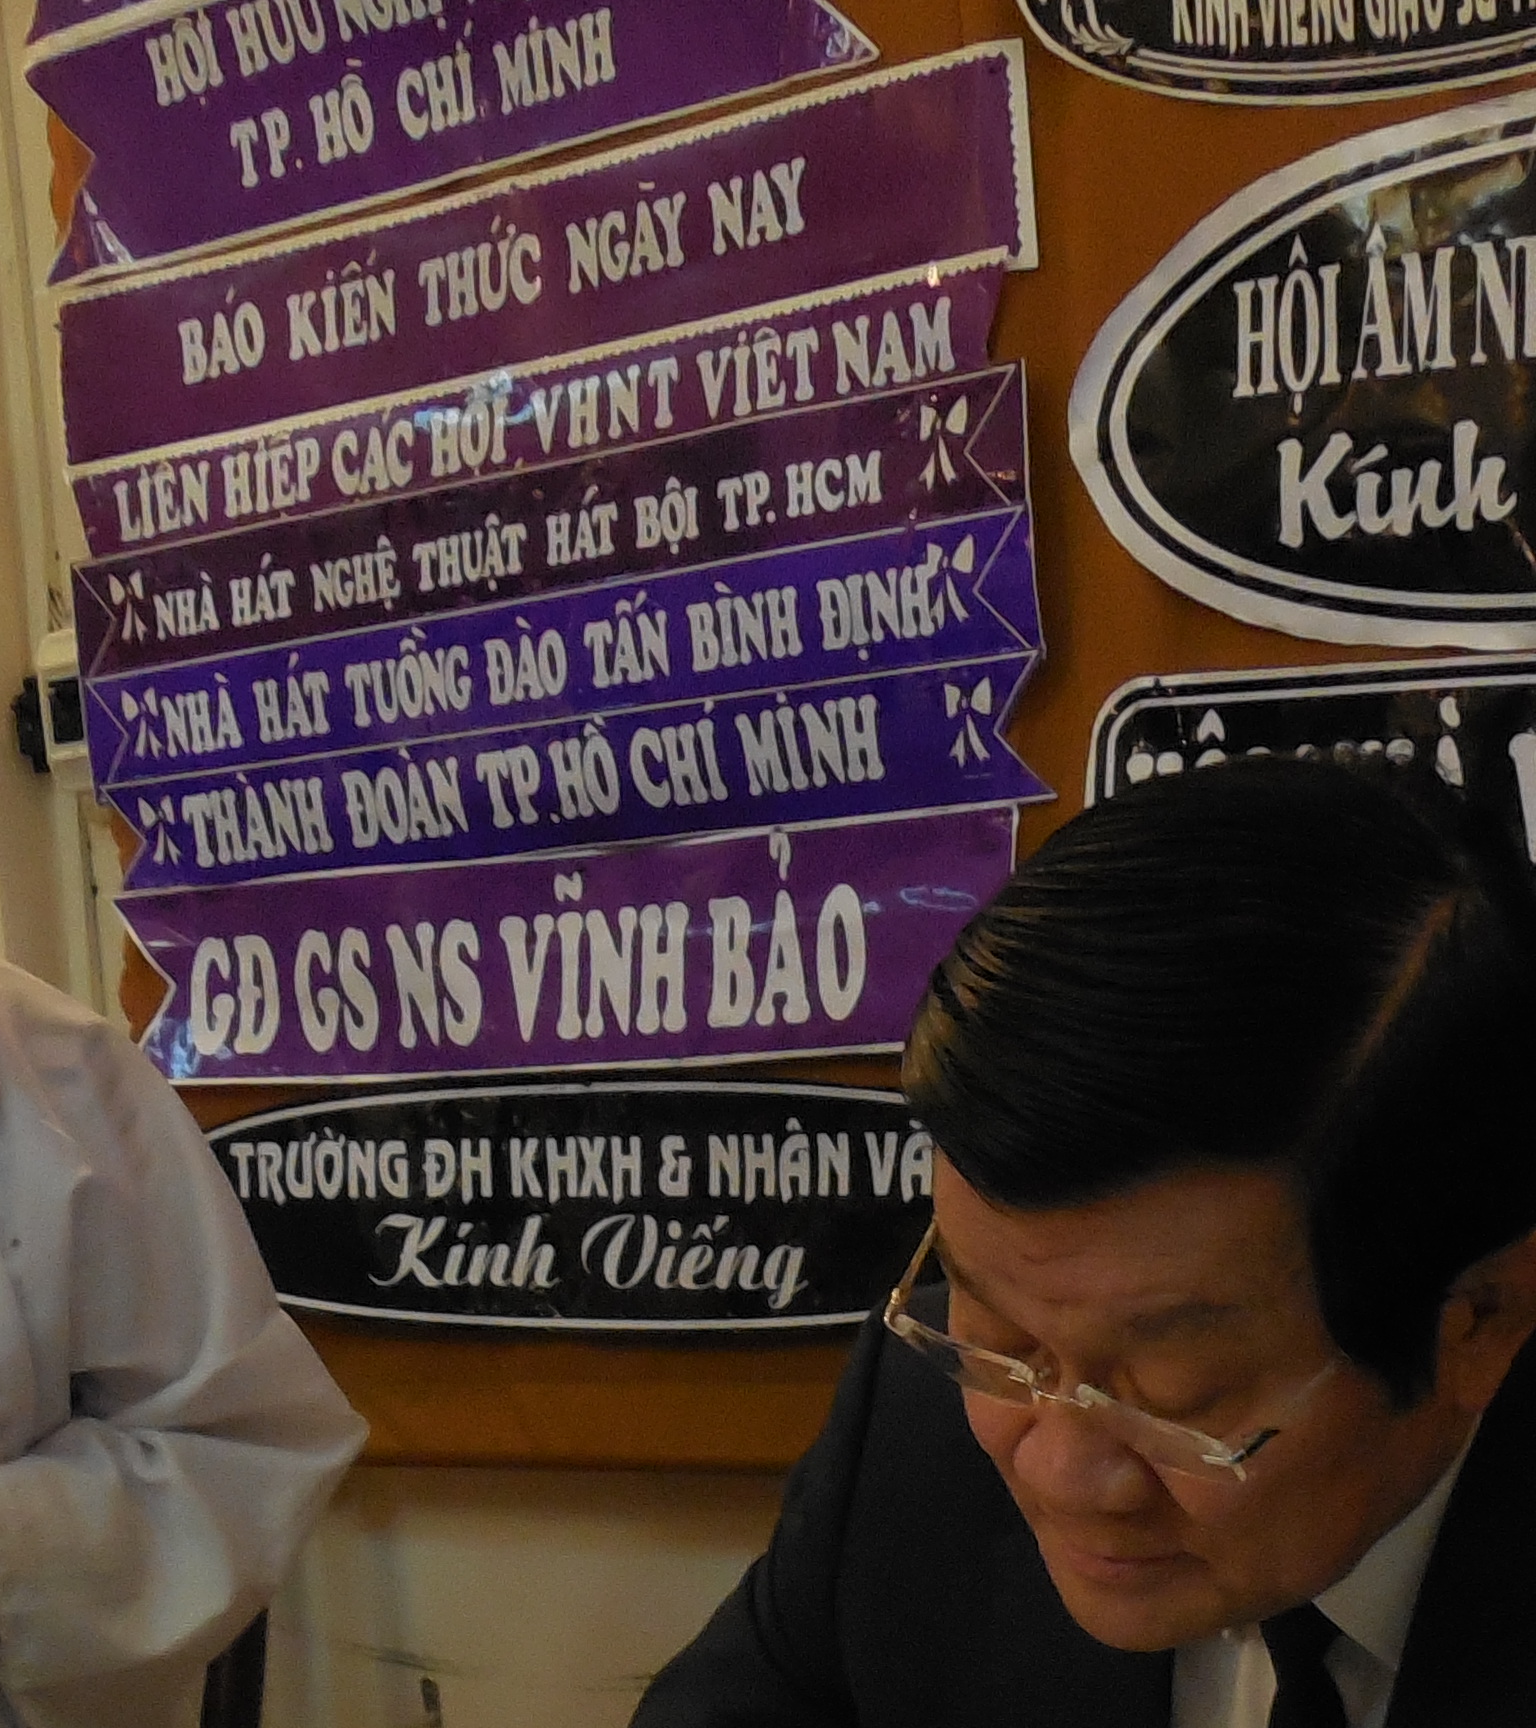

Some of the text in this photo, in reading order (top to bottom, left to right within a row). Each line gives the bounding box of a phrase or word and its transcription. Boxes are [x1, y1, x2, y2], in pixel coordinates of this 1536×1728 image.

[396, 19, 476, 141] CHÍ
[178, 285, 265, 386] BÁO
[286, 249, 396, 360] KIẾN
[418, 214, 542, 326] THỨC
[708, 157, 805, 255] NAY
[1232, 234, 1342, 413] HỘI
[1352, 224, 1456, 380] ÂM
[530, 357, 678, 454] VHNT
[832, 296, 955, 395] NAM
[153, 571, 220, 641] NHÀ
[229, 552, 295, 627] HÁT
[310, 534, 401, 612] NGHỆ
[413, 513, 526, 592] THUẬT
[546, 484, 619, 566] HÁT
[633, 476, 699, 554] BỘI
[1277, 420, 1517, 548] Kính
[162, 564, 935, 757] NHÀ HÁT TUỒNG ĐÀO TẤN BÌNH ĐỊNH
[182, 771, 333, 868] THÀNH
[344, 739, 468, 850] ĐOÀN
[631, 700, 728, 809] CHÍ
[190, 827, 864, 1055] GĐ GS NS VĨNH BẢO
[230, 1127, 408, 1205] TRƯỜNG
[422, 1135, 493, 1205] ĐH
[509, 1135, 642, 1205] KHXH
[658, 1134, 692, 1197] &
[708, 1117, 850, 1205] NHÂN
[368, 1213, 810, 1309] Kính Viếng
